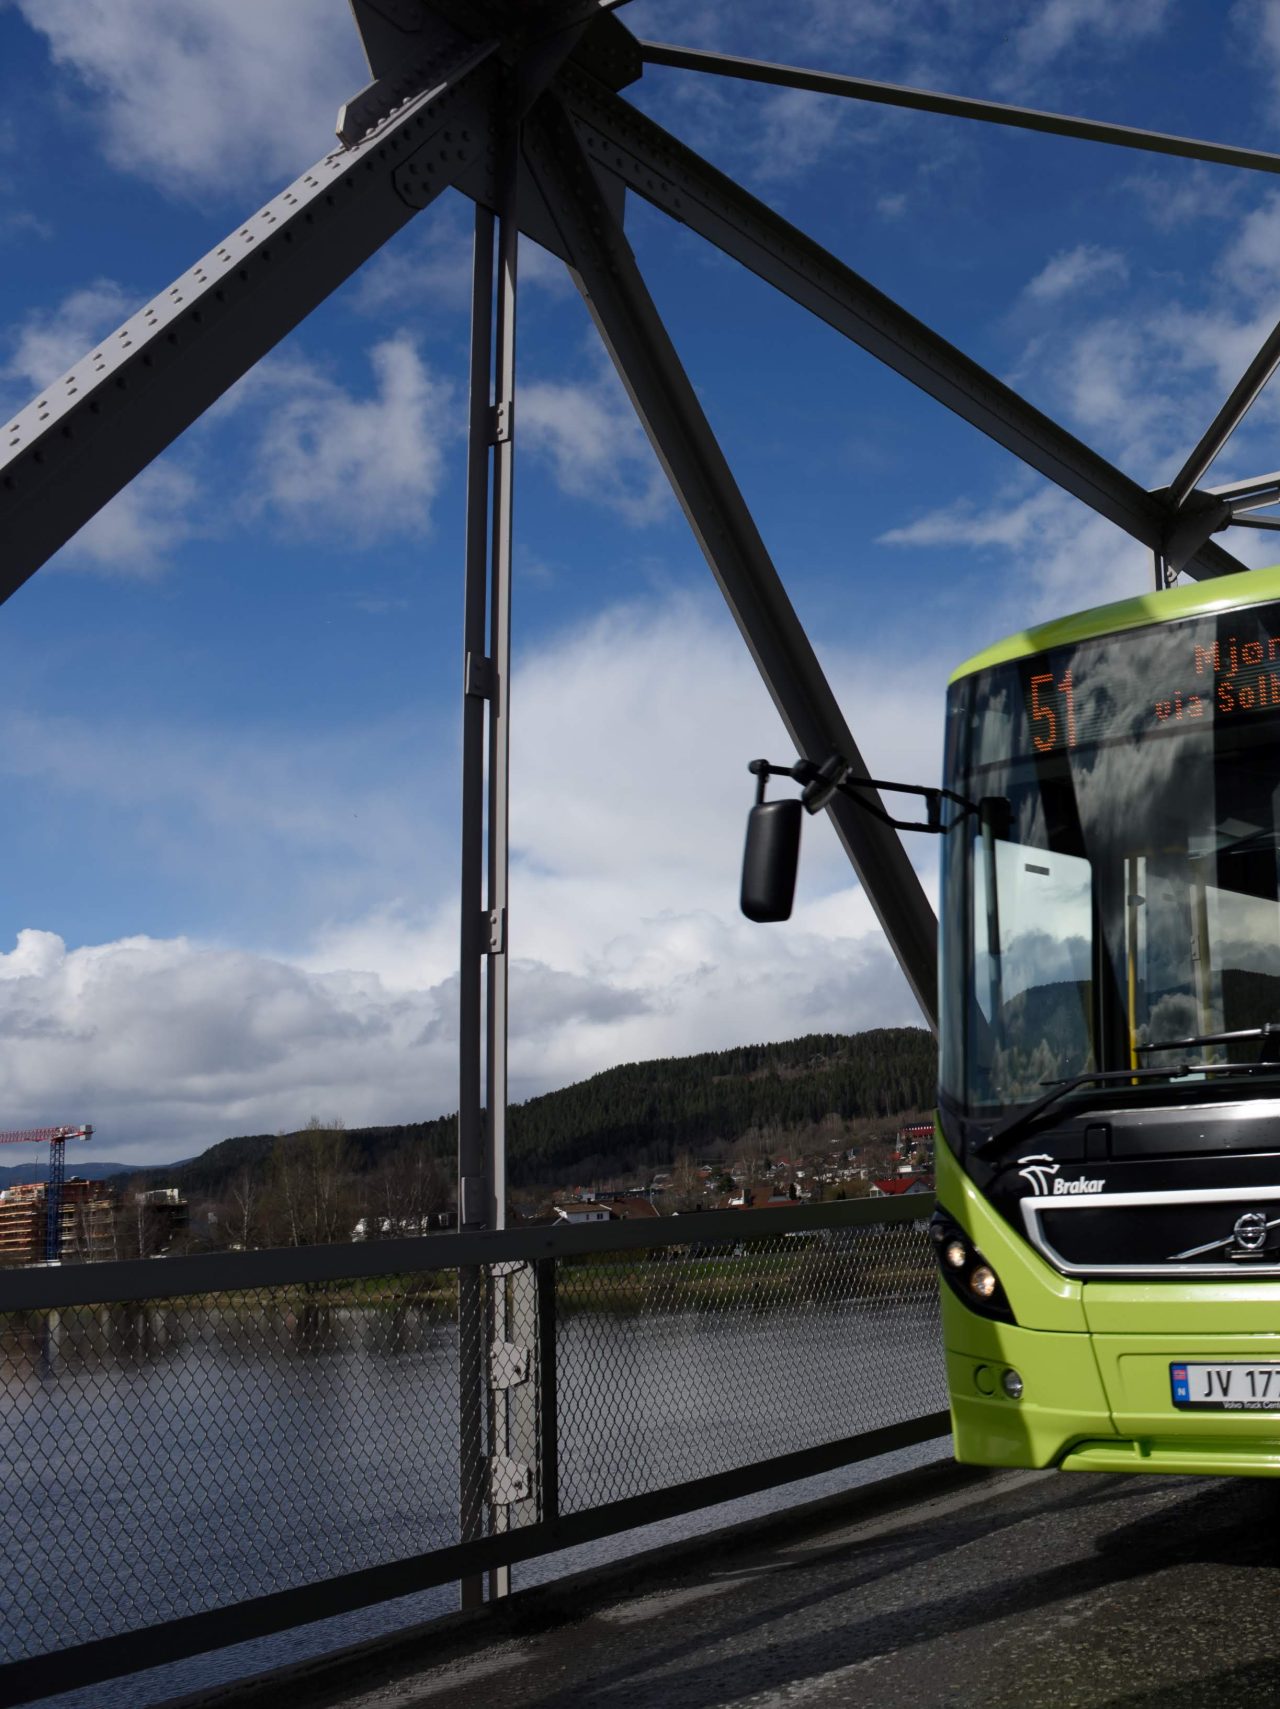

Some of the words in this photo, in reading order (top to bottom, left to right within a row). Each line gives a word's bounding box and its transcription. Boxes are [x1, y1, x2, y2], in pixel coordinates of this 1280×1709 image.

[1030, 670, 1076, 752] 51
[1155, 690, 1204, 722] via
[1053, 1176, 1105, 1195] Brakar
[1177, 1387, 1186, 1396] N
[1204, 1370, 1232, 1398] JV
[1222, 1400, 1243, 1409] Volvo
[1243, 1400, 1262, 1409] Truck
